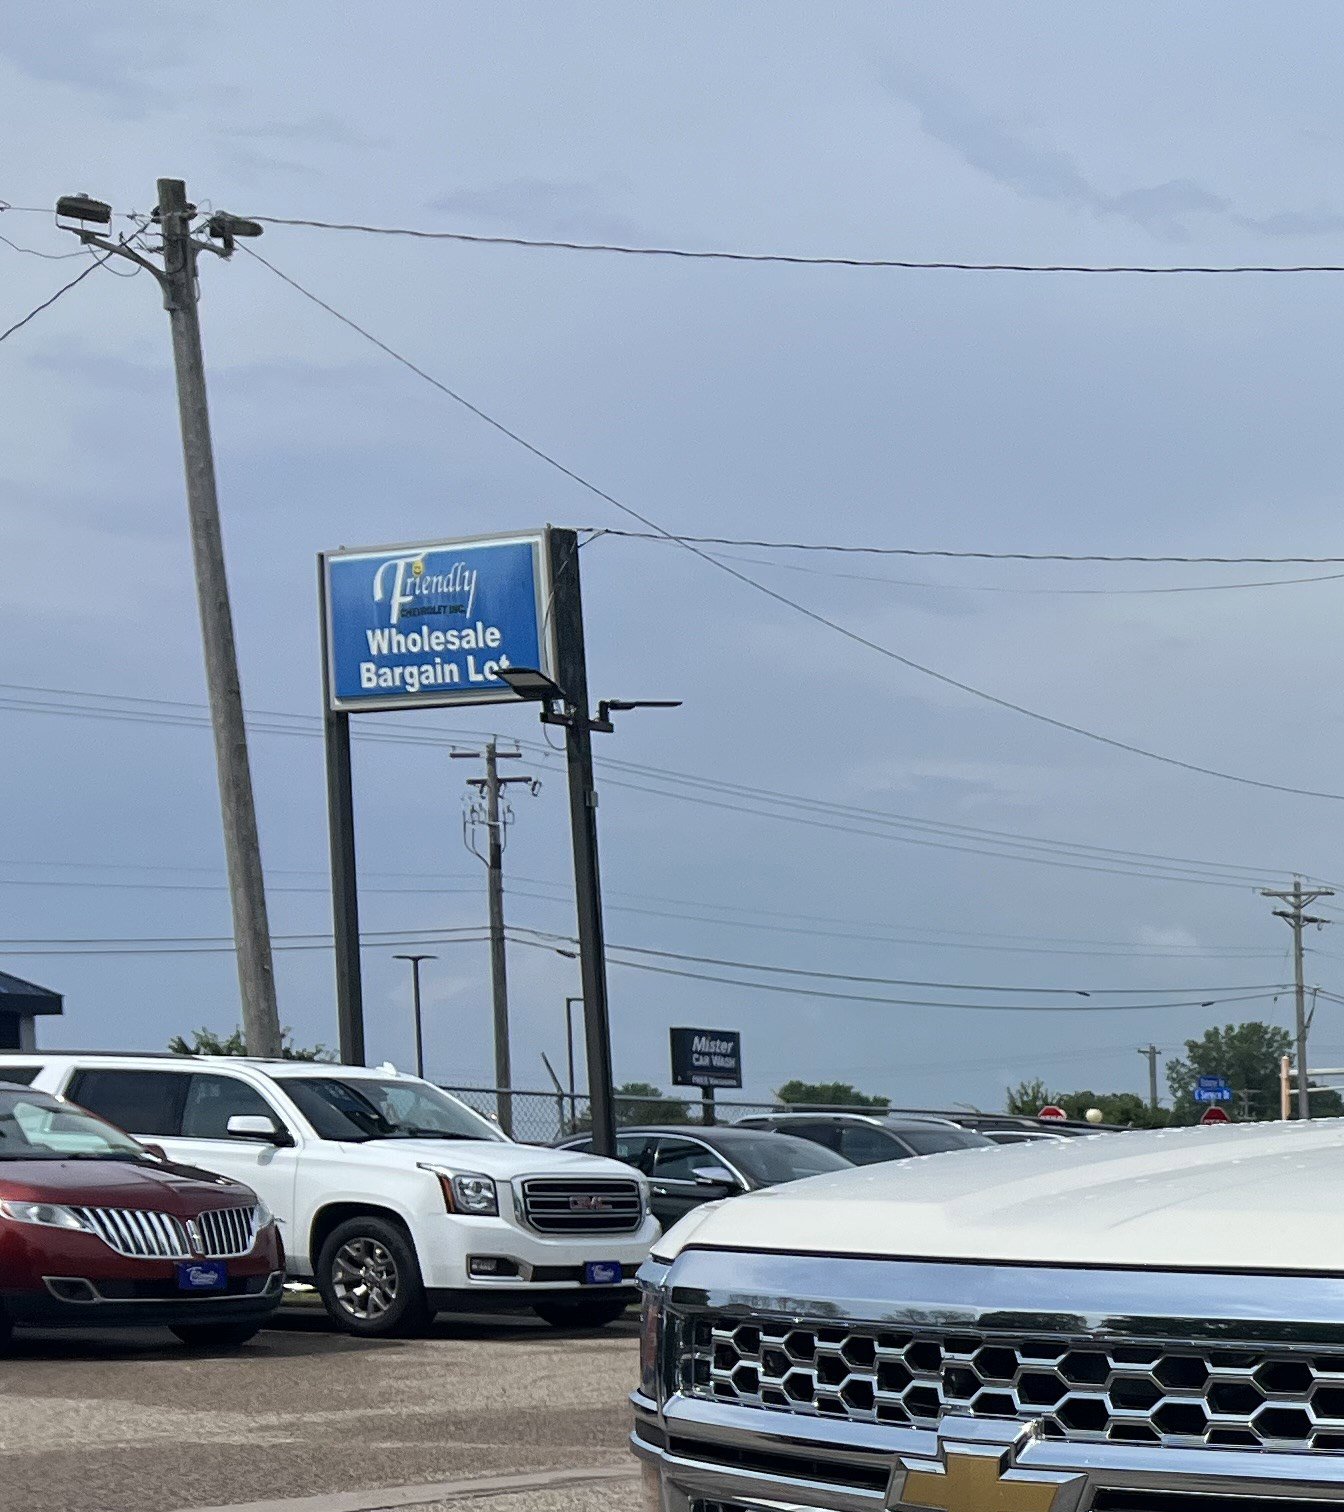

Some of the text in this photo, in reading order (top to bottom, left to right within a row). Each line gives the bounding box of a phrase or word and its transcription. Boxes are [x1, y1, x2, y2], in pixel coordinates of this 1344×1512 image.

[373, 551, 477, 624] Friendly
[366, 621, 501, 656] Wholesale
[359, 658, 459, 692] Bargain
[692, 1035, 734, 1054] Mister
